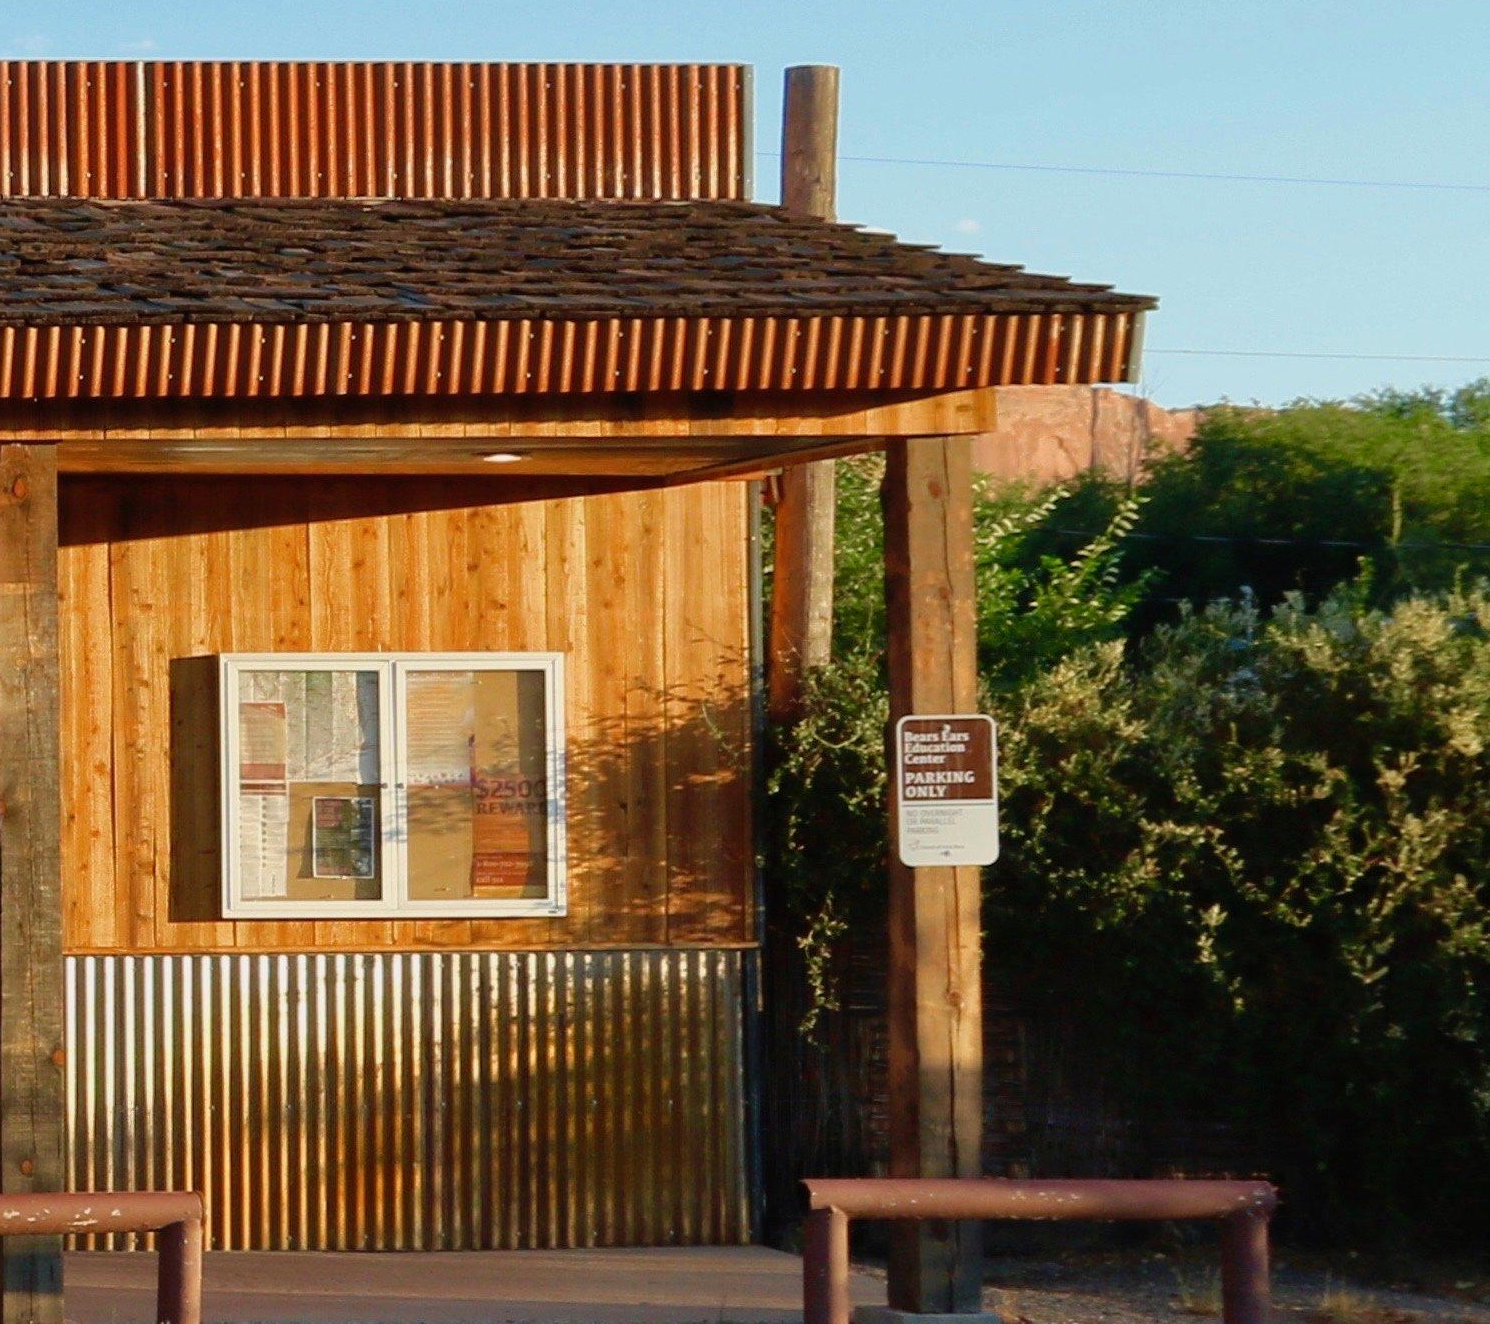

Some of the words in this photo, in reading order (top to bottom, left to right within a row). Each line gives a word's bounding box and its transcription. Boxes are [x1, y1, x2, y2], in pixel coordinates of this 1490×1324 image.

[904, 731, 938, 742] Bears
[942, 732, 969, 742] Ears
[904, 743, 966, 753] Education
[904, 754, 946, 764] Center
[905, 771, 975, 783] PARKING
[905, 786, 947, 797] ONLY
